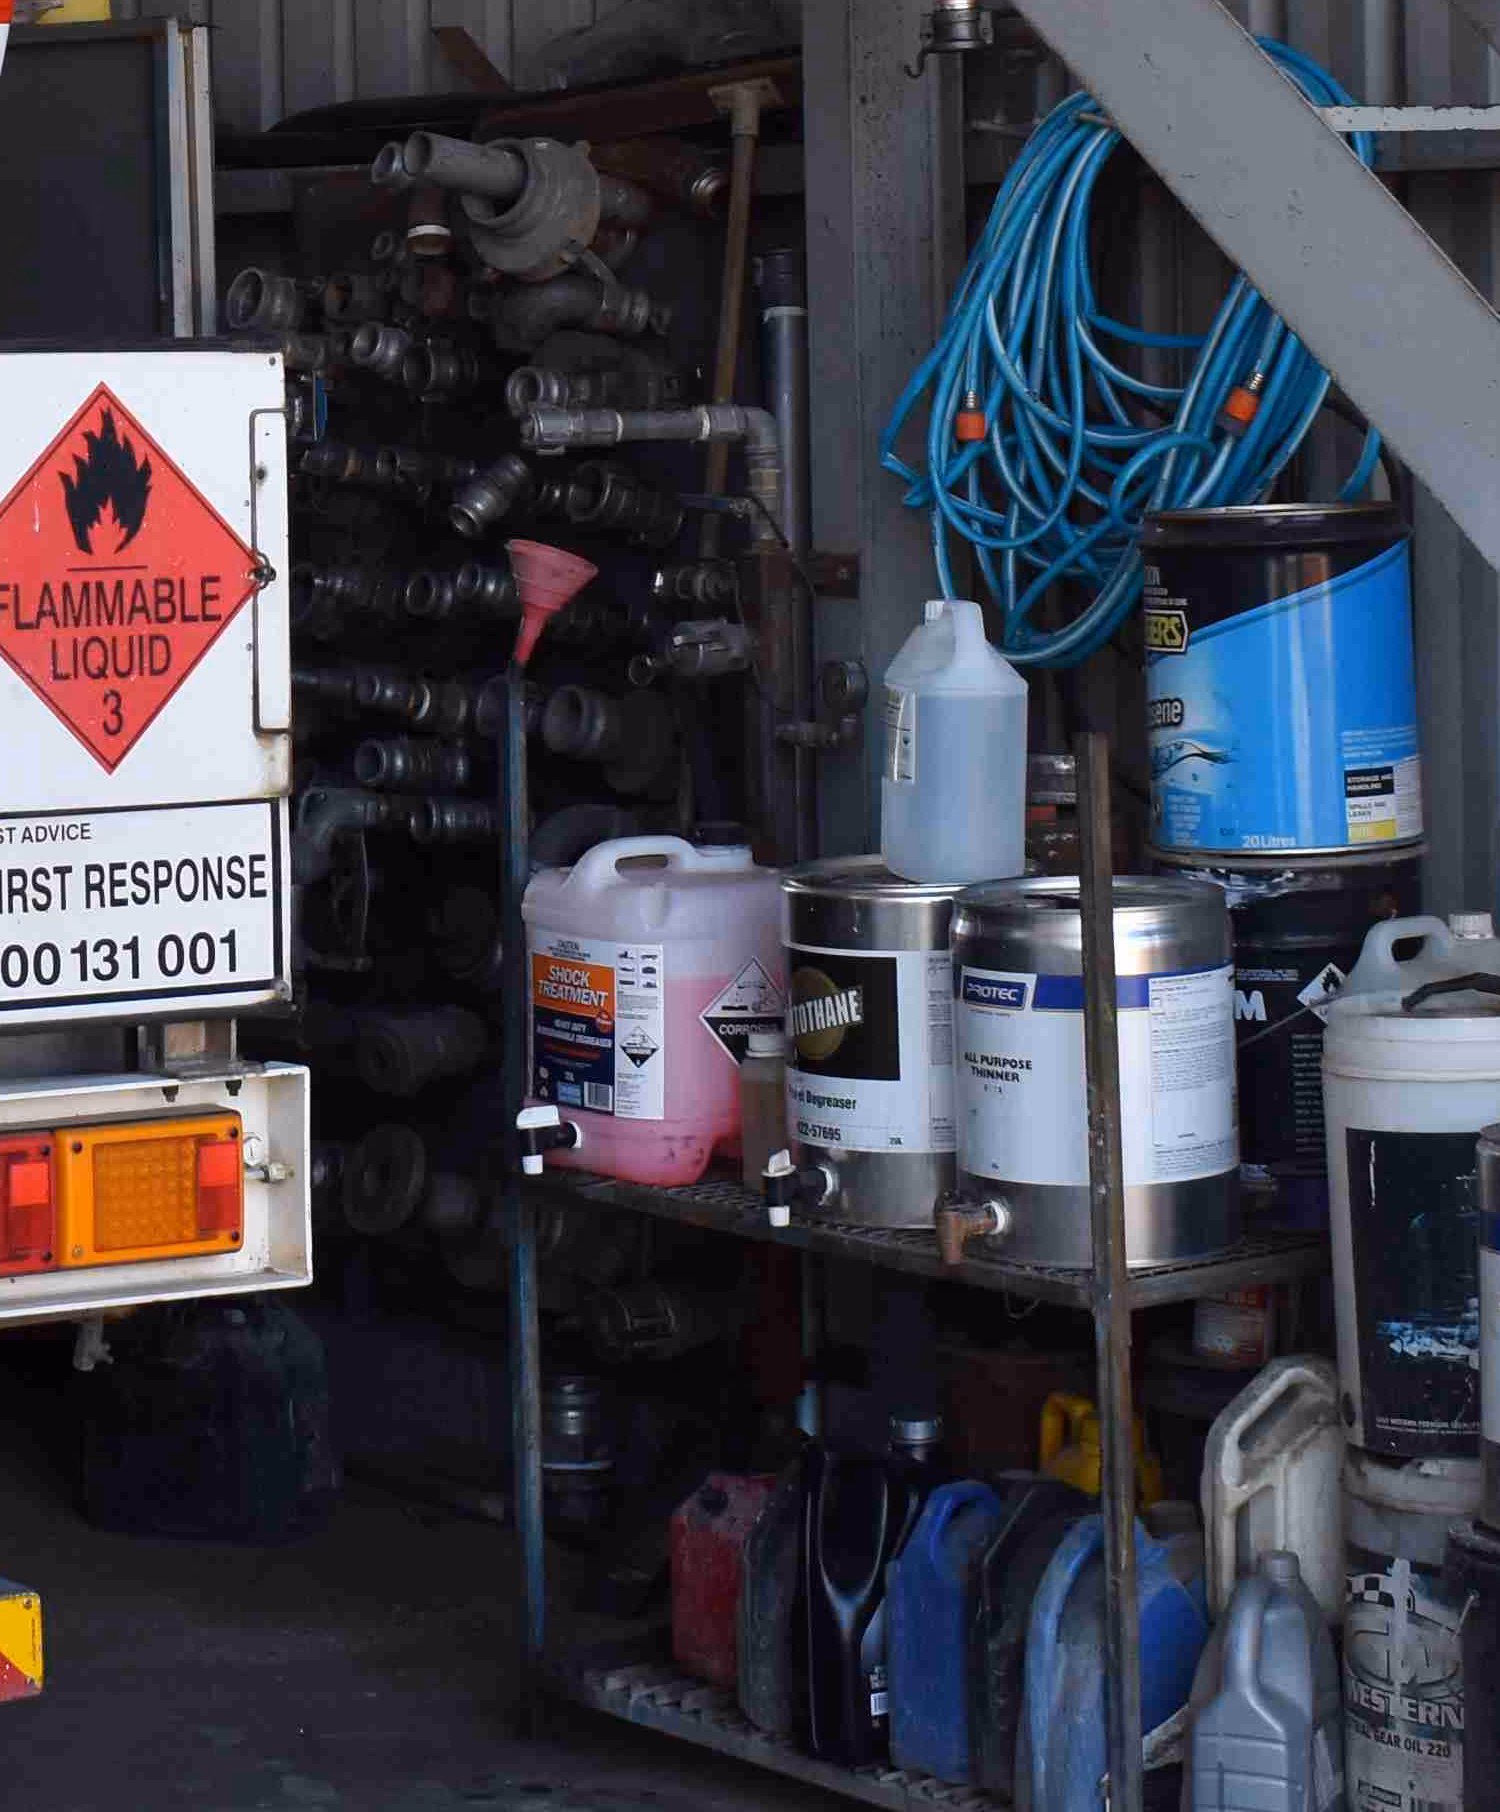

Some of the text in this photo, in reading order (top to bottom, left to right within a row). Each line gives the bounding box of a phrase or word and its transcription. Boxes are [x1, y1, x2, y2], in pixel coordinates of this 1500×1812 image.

[51, 635, 171, 680] LIQUID
[103, 689, 123, 736] 3
[21, 823, 91, 844] ADVICE
[84, 854, 268, 909] RESPONSE
[71, 935, 140, 982] 131
[158, 929, 237, 978] 001
[549, 965, 591, 987] SHOCK
[536, 980, 609, 1007] TREATMENT
[967, 982, 1020, 1001] PROTEC
[964, 1051, 1033, 1070] ALL PURPOSE
[970, 1065, 1020, 1083] THINNER
[806, 1089, 857, 1110] Degreaser
[1373, 1730, 1450, 1758] GEAR OIL 220
